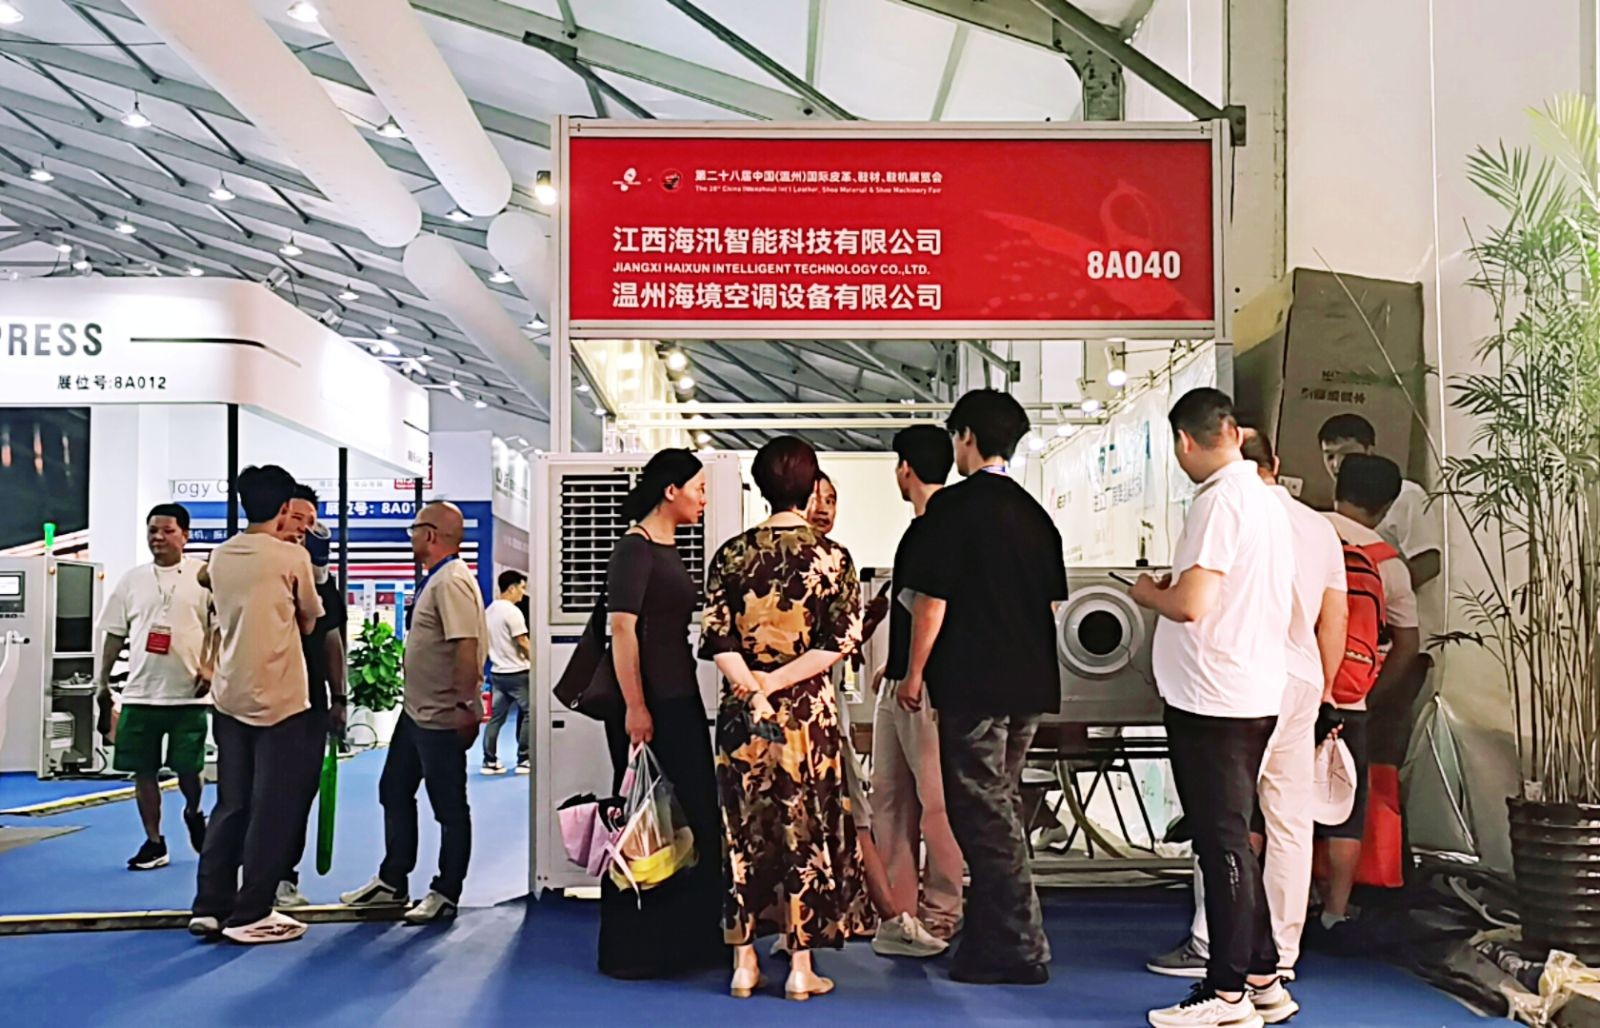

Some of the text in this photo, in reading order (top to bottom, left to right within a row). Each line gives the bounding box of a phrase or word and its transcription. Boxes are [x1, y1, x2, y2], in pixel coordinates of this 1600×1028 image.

[612, 226, 942, 256] 江西海汛智能科技有限公司
[612, 262, 662, 273] JIANGXI
[664, 263, 711, 274] HAIXUN
[713, 263, 791, 274] INTELLIGENT
[793, 263, 878, 275] TECHNOLOGY
[1087, 250, 1181, 280] 8A040
[612, 281, 942, 311] 温州海境空调设备有限公司
[0, 322, 103, 357] RESS
